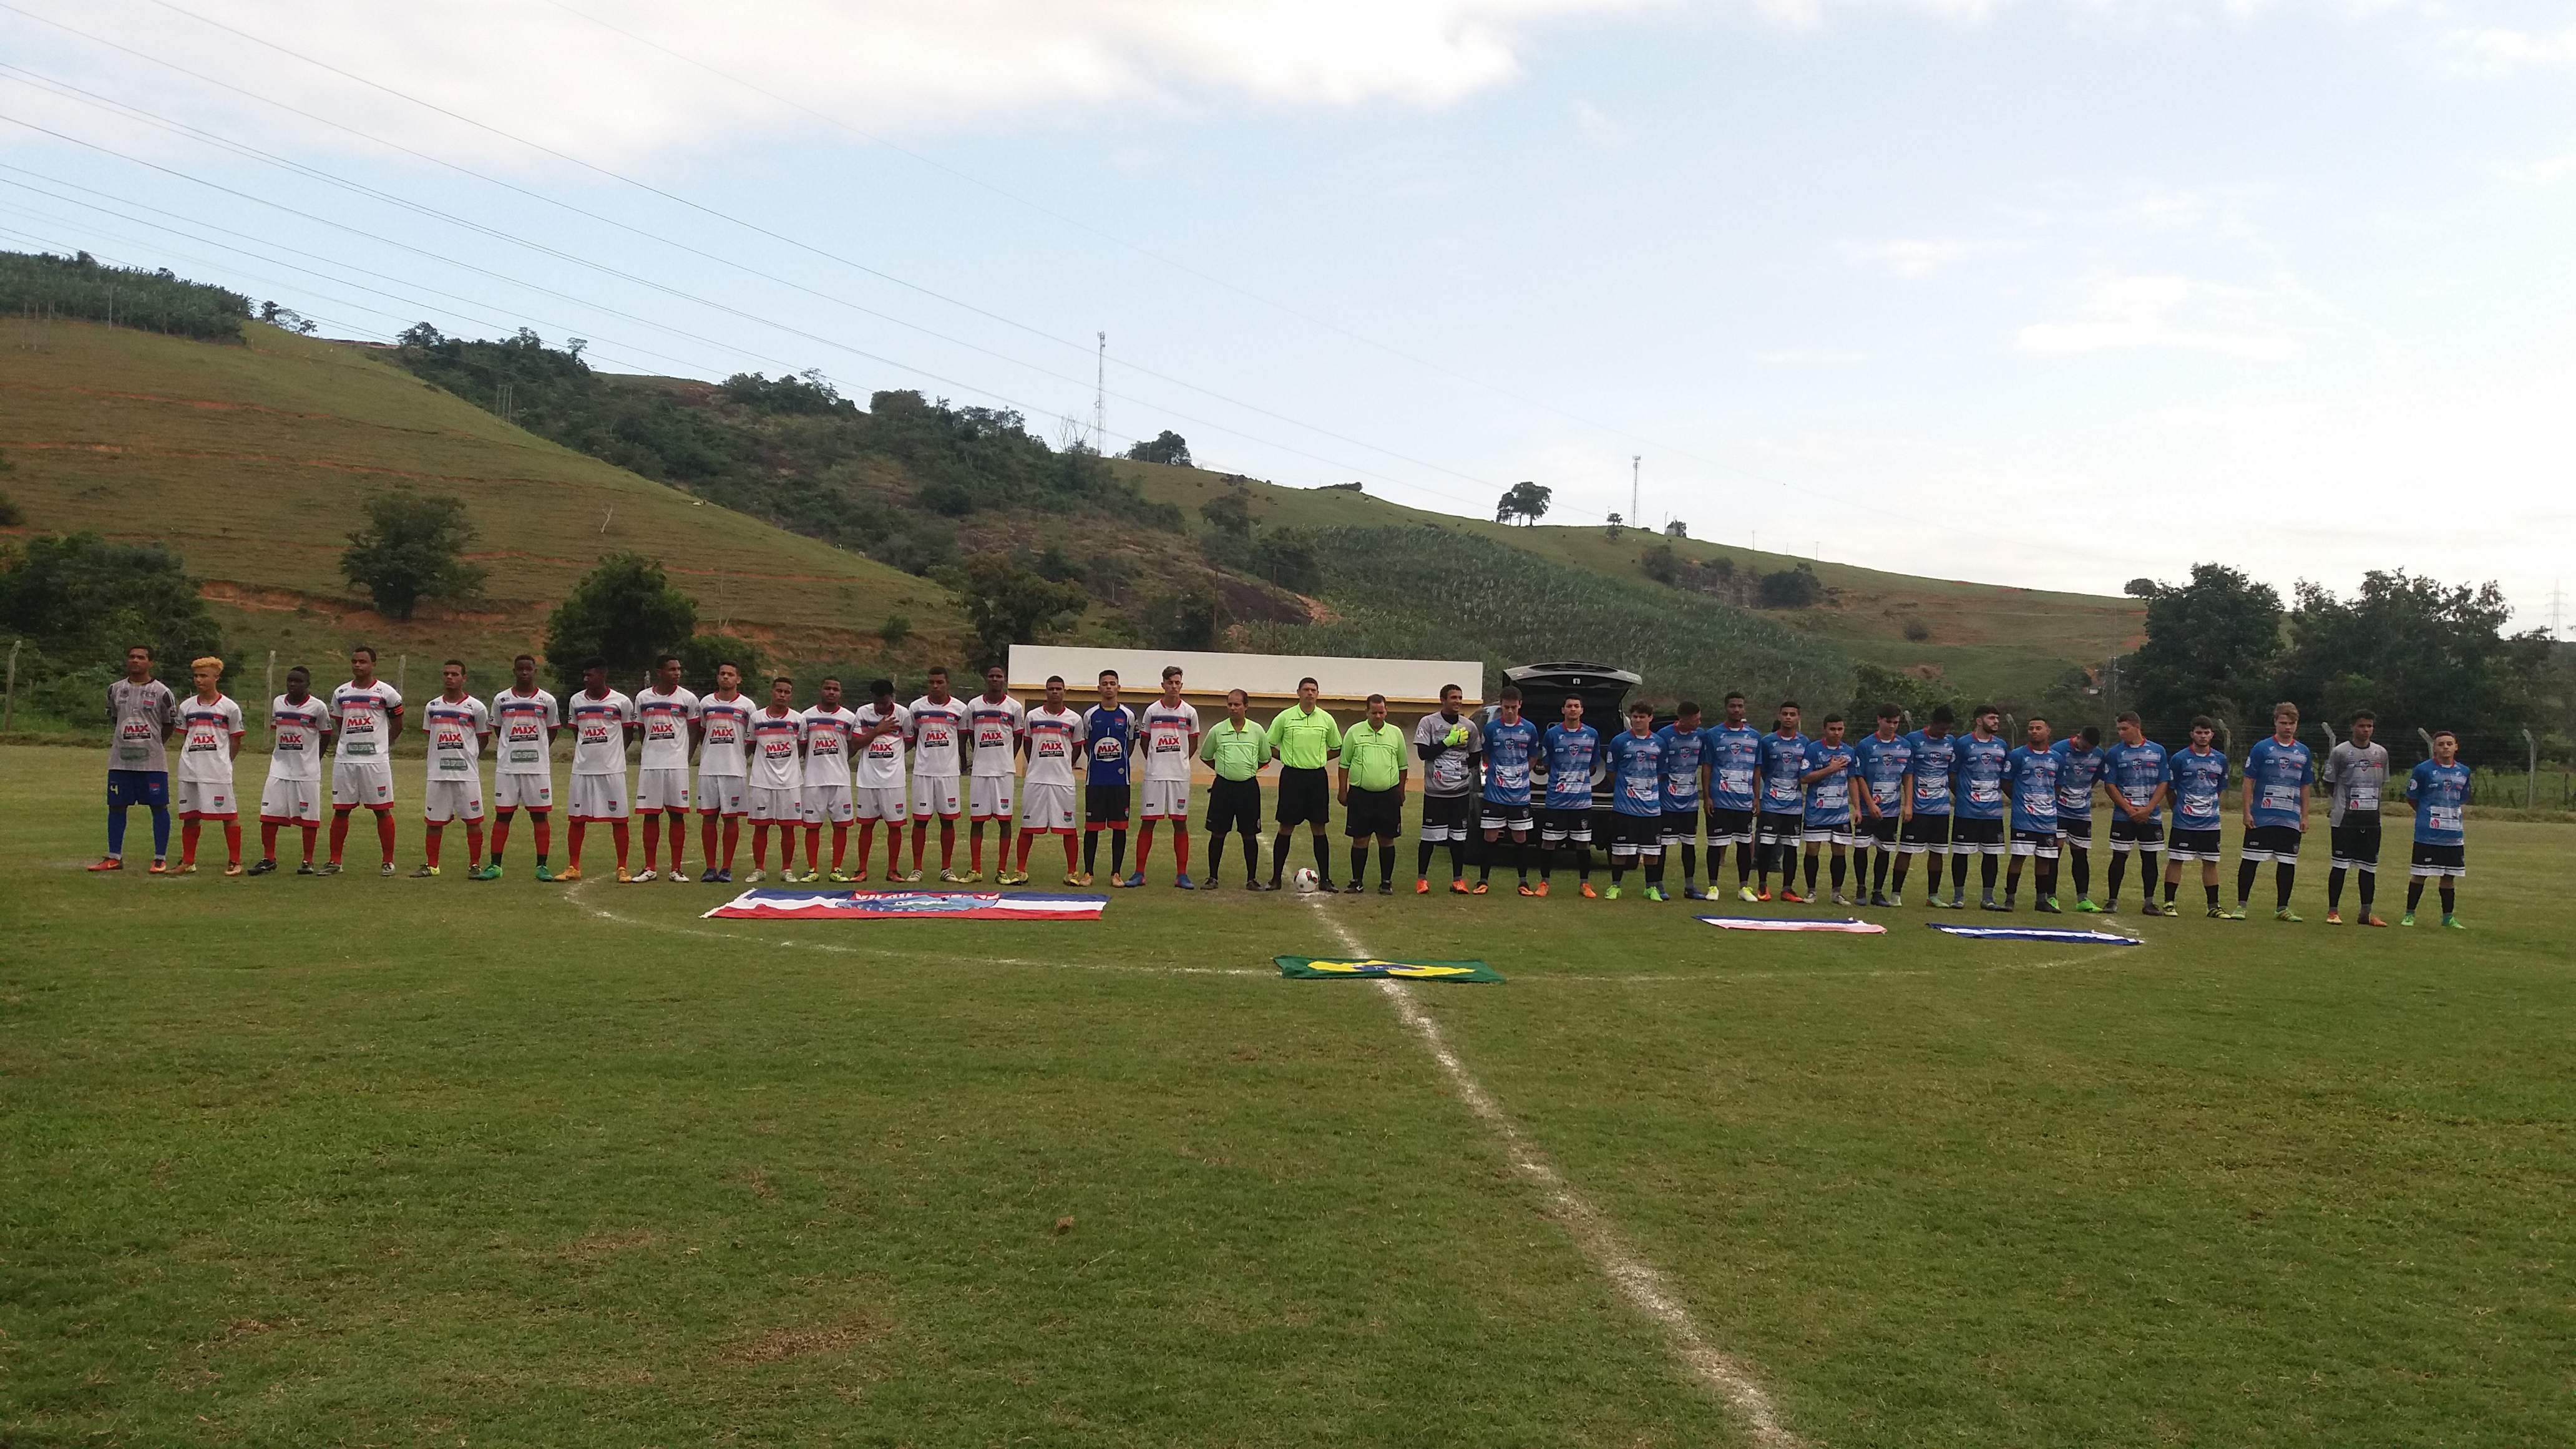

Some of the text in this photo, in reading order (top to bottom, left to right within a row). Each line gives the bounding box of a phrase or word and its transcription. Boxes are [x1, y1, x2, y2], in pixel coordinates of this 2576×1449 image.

[347, 716, 372, 727] MIX
[124, 724, 149, 733] MIX
[510, 725, 537, 735] MIX
[583, 727, 606, 737] MIX
[650, 724, 673, 733] MIX
[711, 728, 734, 737] MIX
[192, 734, 216, 744] MIX
[280, 734, 302, 743] MIX
[438, 733, 462, 743] MIX
[926, 731, 948, 741] MIX
[980, 731, 1003, 741] MIX
[814, 739, 837, 748] MIX
[1041, 742, 1063, 751] MIX
[1158, 737, 1179, 746] MIX
[766, 741, 791, 753] MIX
[870, 743, 893, 751] MIX
[1097, 743, 1120, 753] MIX
[110, 784, 119, 795] 4
